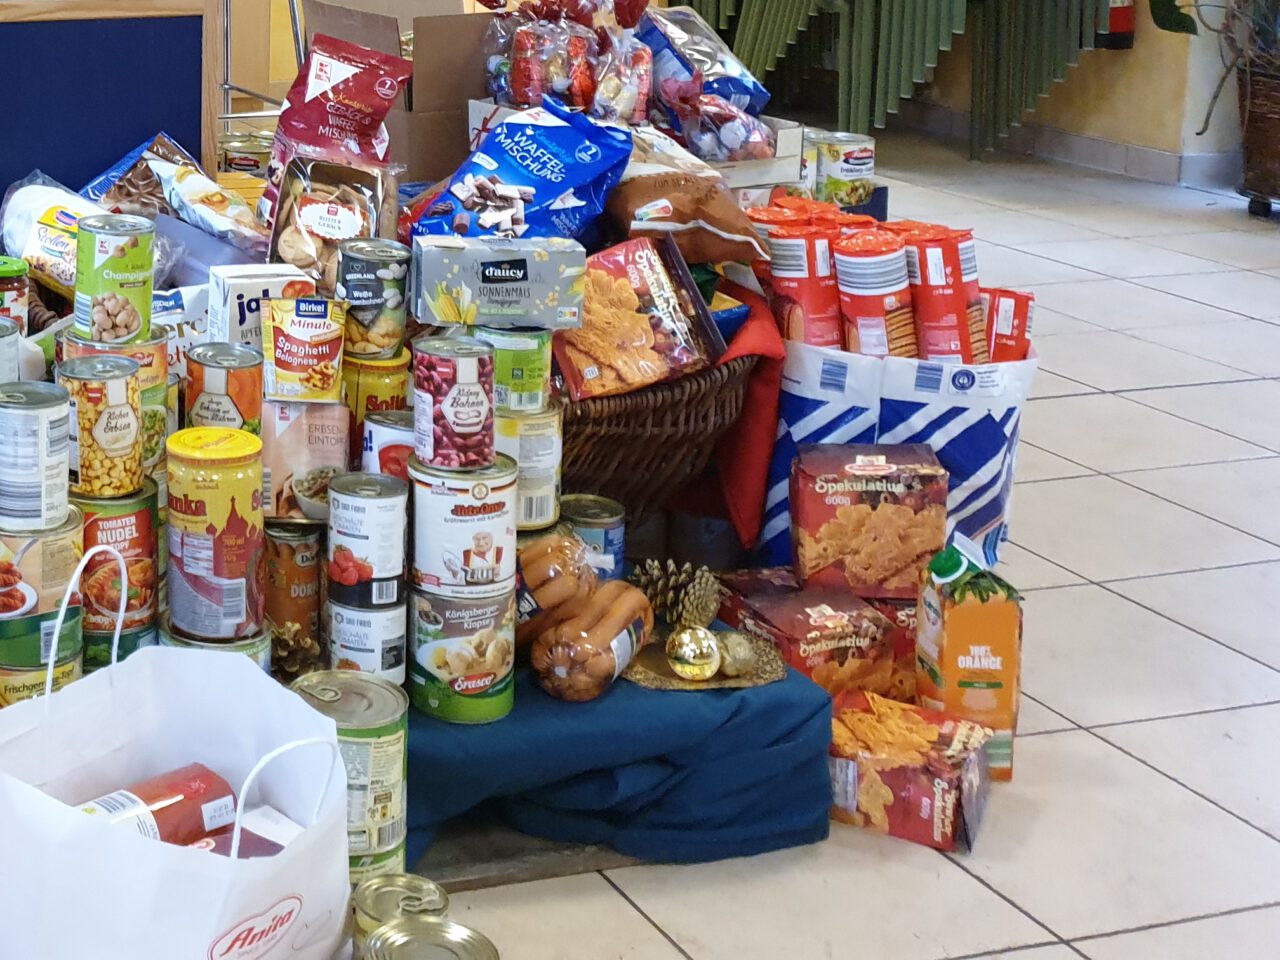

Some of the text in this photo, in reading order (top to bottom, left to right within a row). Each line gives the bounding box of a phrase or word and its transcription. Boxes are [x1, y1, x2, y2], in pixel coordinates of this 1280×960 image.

[496, 132, 565, 186] MISCHUNG
[513, 130, 567, 177] WAFFEL-
[484, 266, 525, 280] d'aucy
[478, 286, 531, 298] SONNENMAIS
[299, 303, 324, 313] Birkel
[290, 316, 332, 329] Minuto
[277, 337, 330, 356] Spaghetti
[275, 350, 320, 367] Bolognese
[457, 386, 480, 400] Kidney
[450, 396, 484, 409] Bohnen
[815, 477, 905, 495] Spekulatius
[825, 495, 851, 507] 600g
[98, 515, 136, 528] TOMATEN
[97, 525, 139, 542] NUDEL
[463, 617, 491, 628] Klopse
[799, 634, 870, 655] Spekulatius
[957, 653, 1003, 669] ORANGE
[3, 668, 75, 694] Frischgemse-Topf
[454, 673, 494, 691] Erasco
[219, 906, 295, 957] Anita
